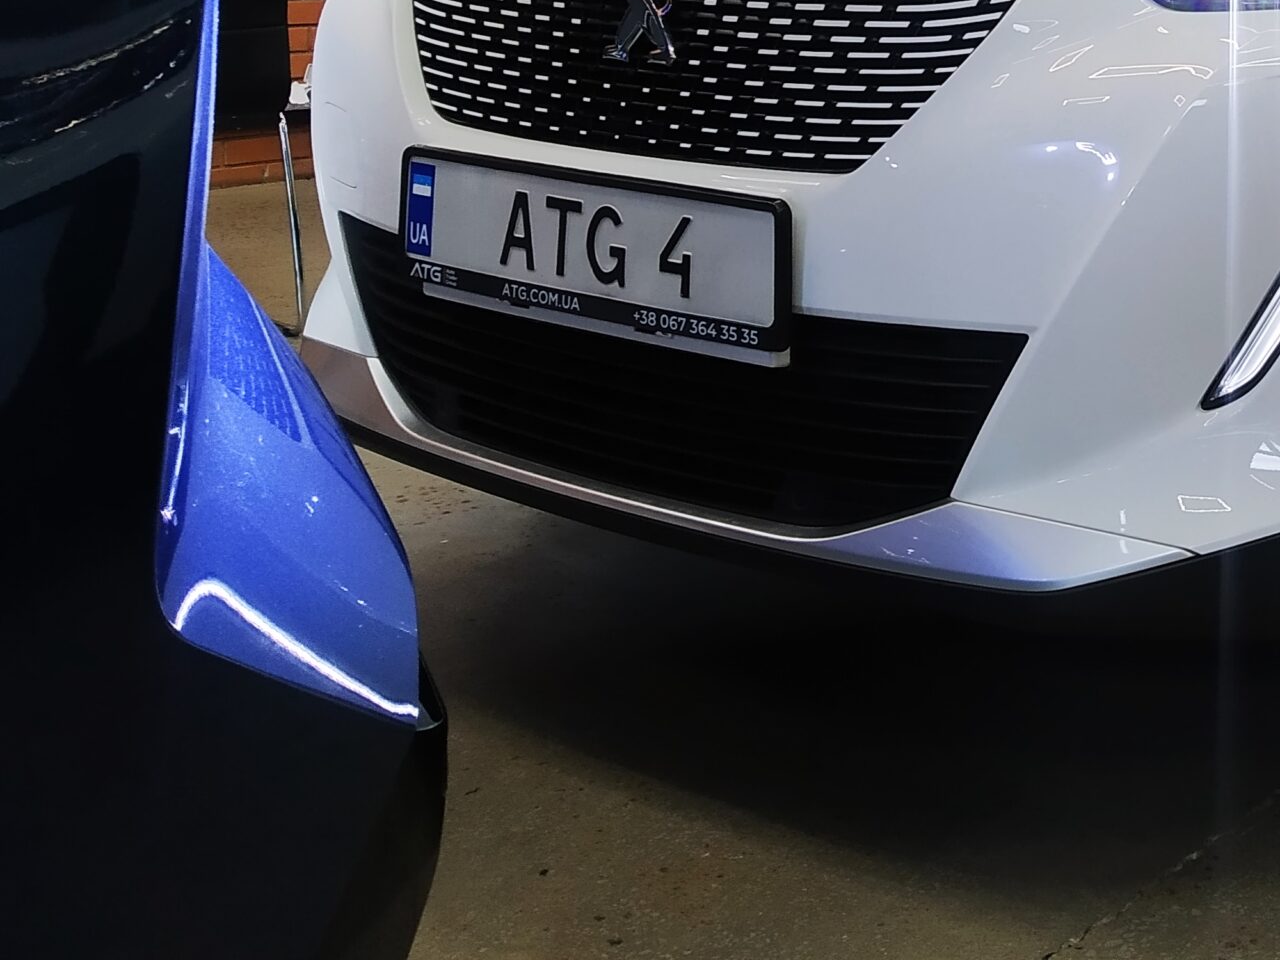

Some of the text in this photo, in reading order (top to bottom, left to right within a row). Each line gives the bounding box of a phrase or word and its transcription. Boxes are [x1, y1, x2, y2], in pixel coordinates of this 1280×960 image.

[410, 221, 429, 246] UA
[500, 190, 693, 299] ATG 4
[409, 262, 442, 283] ATG
[501, 283, 580, 312] ATG.COM.UA
[633, 310, 758, 345] +38 067 364 35 35
